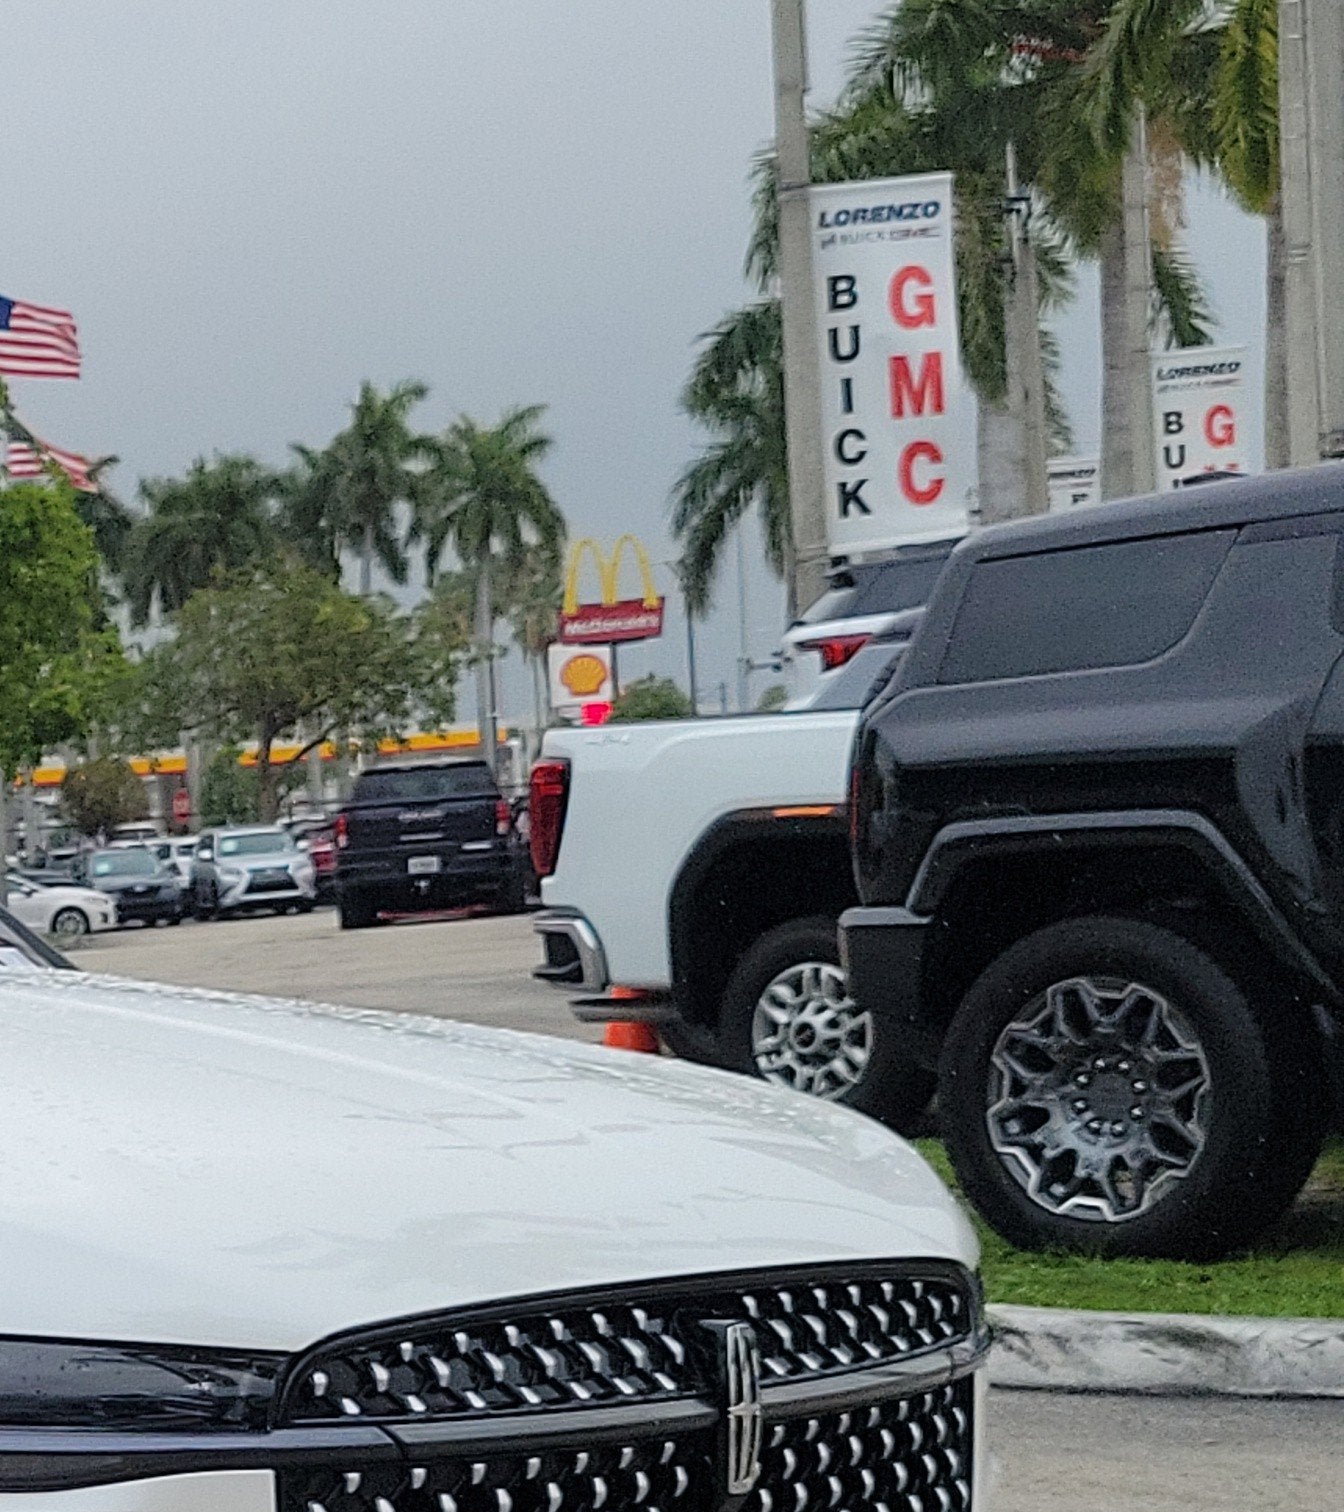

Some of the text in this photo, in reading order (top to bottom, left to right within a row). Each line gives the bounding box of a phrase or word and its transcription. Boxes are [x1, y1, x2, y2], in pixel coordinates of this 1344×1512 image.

[819, 201, 940, 228] LORENZO
[827, 275, 871, 518] BUICK
[888, 265, 945, 505] GMC
